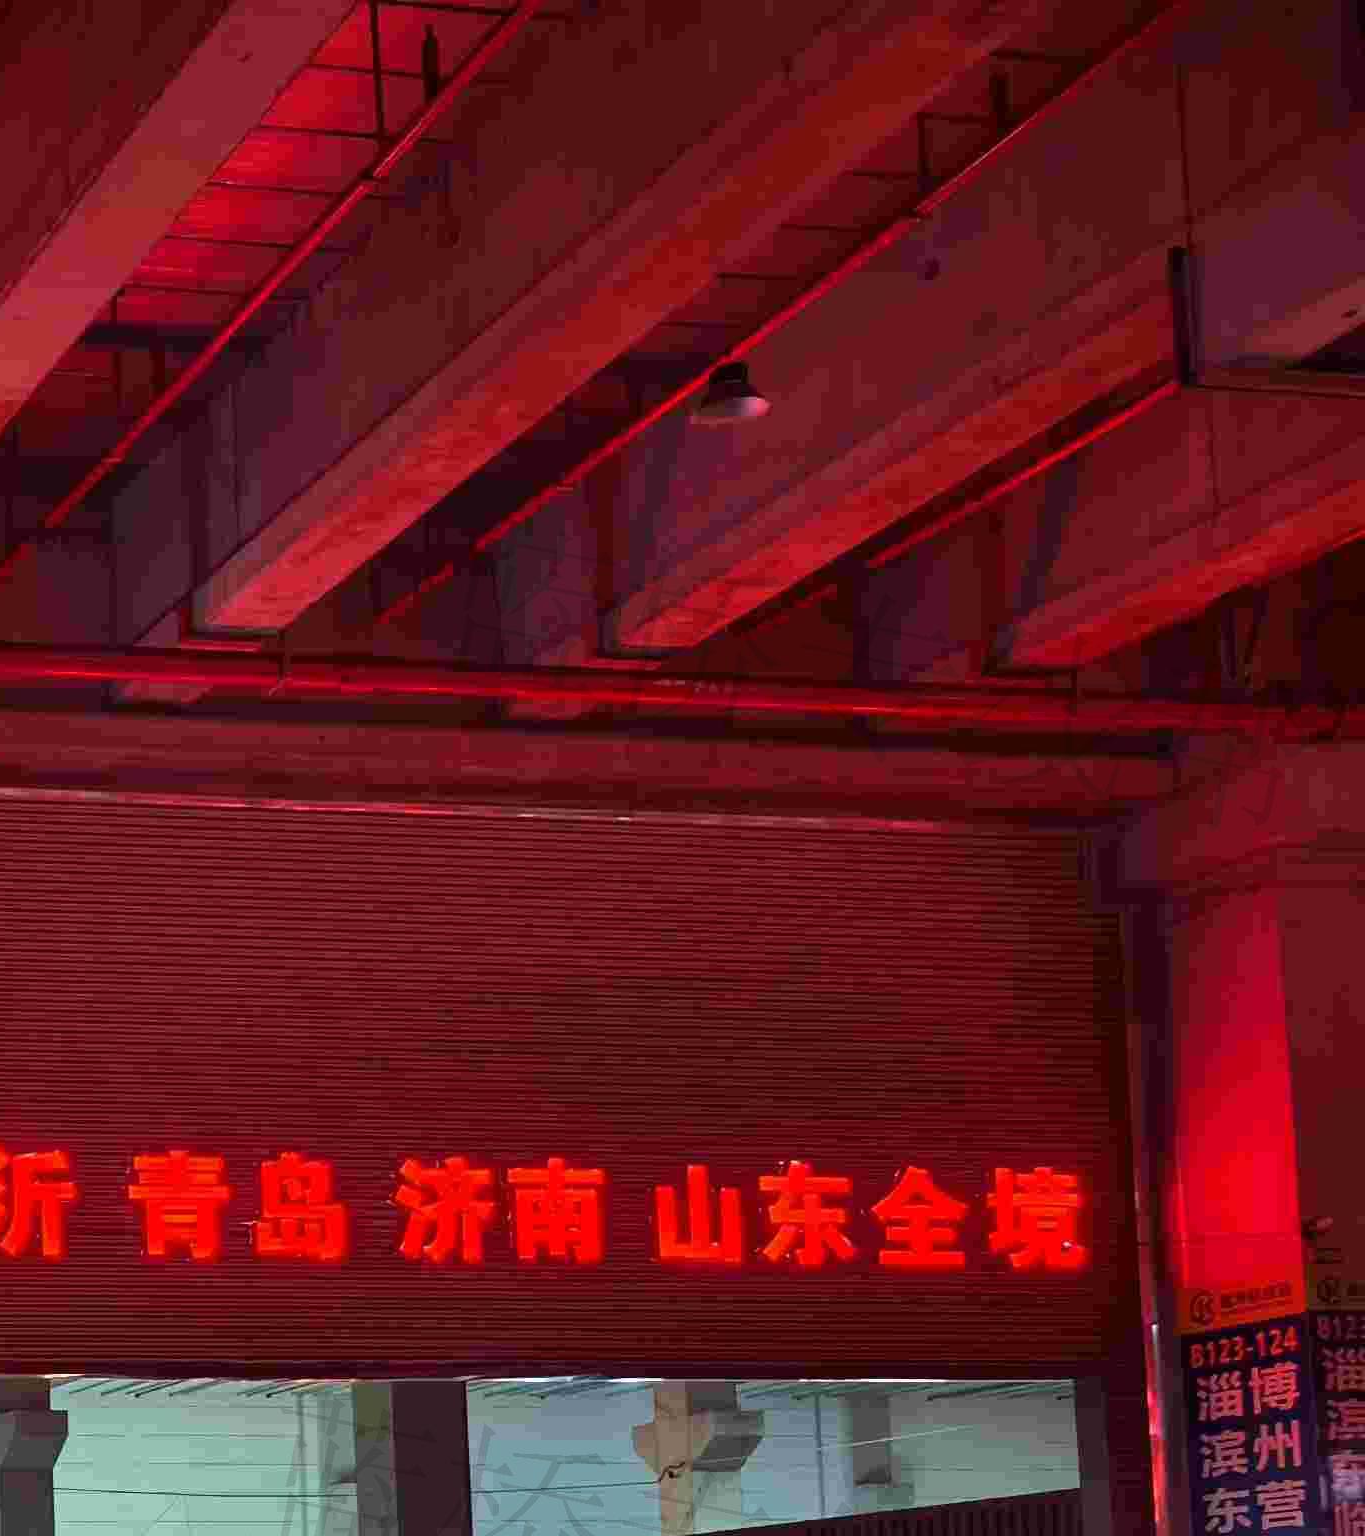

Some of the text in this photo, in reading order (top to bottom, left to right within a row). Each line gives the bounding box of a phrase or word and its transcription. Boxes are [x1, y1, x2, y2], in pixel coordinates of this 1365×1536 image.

[127, 1148, 347, 1263] 青岛
[395, 1156, 607, 1264] 济南
[652, 1158, 1091, 1270] 山东全境
[1188, 1326, 1299, 1369] B123-124
[1196, 1359, 1301, 1422] 淄博
[1199, 1418, 1303, 1480] 滨州
[1204, 1478, 1307, 1535] 东营
